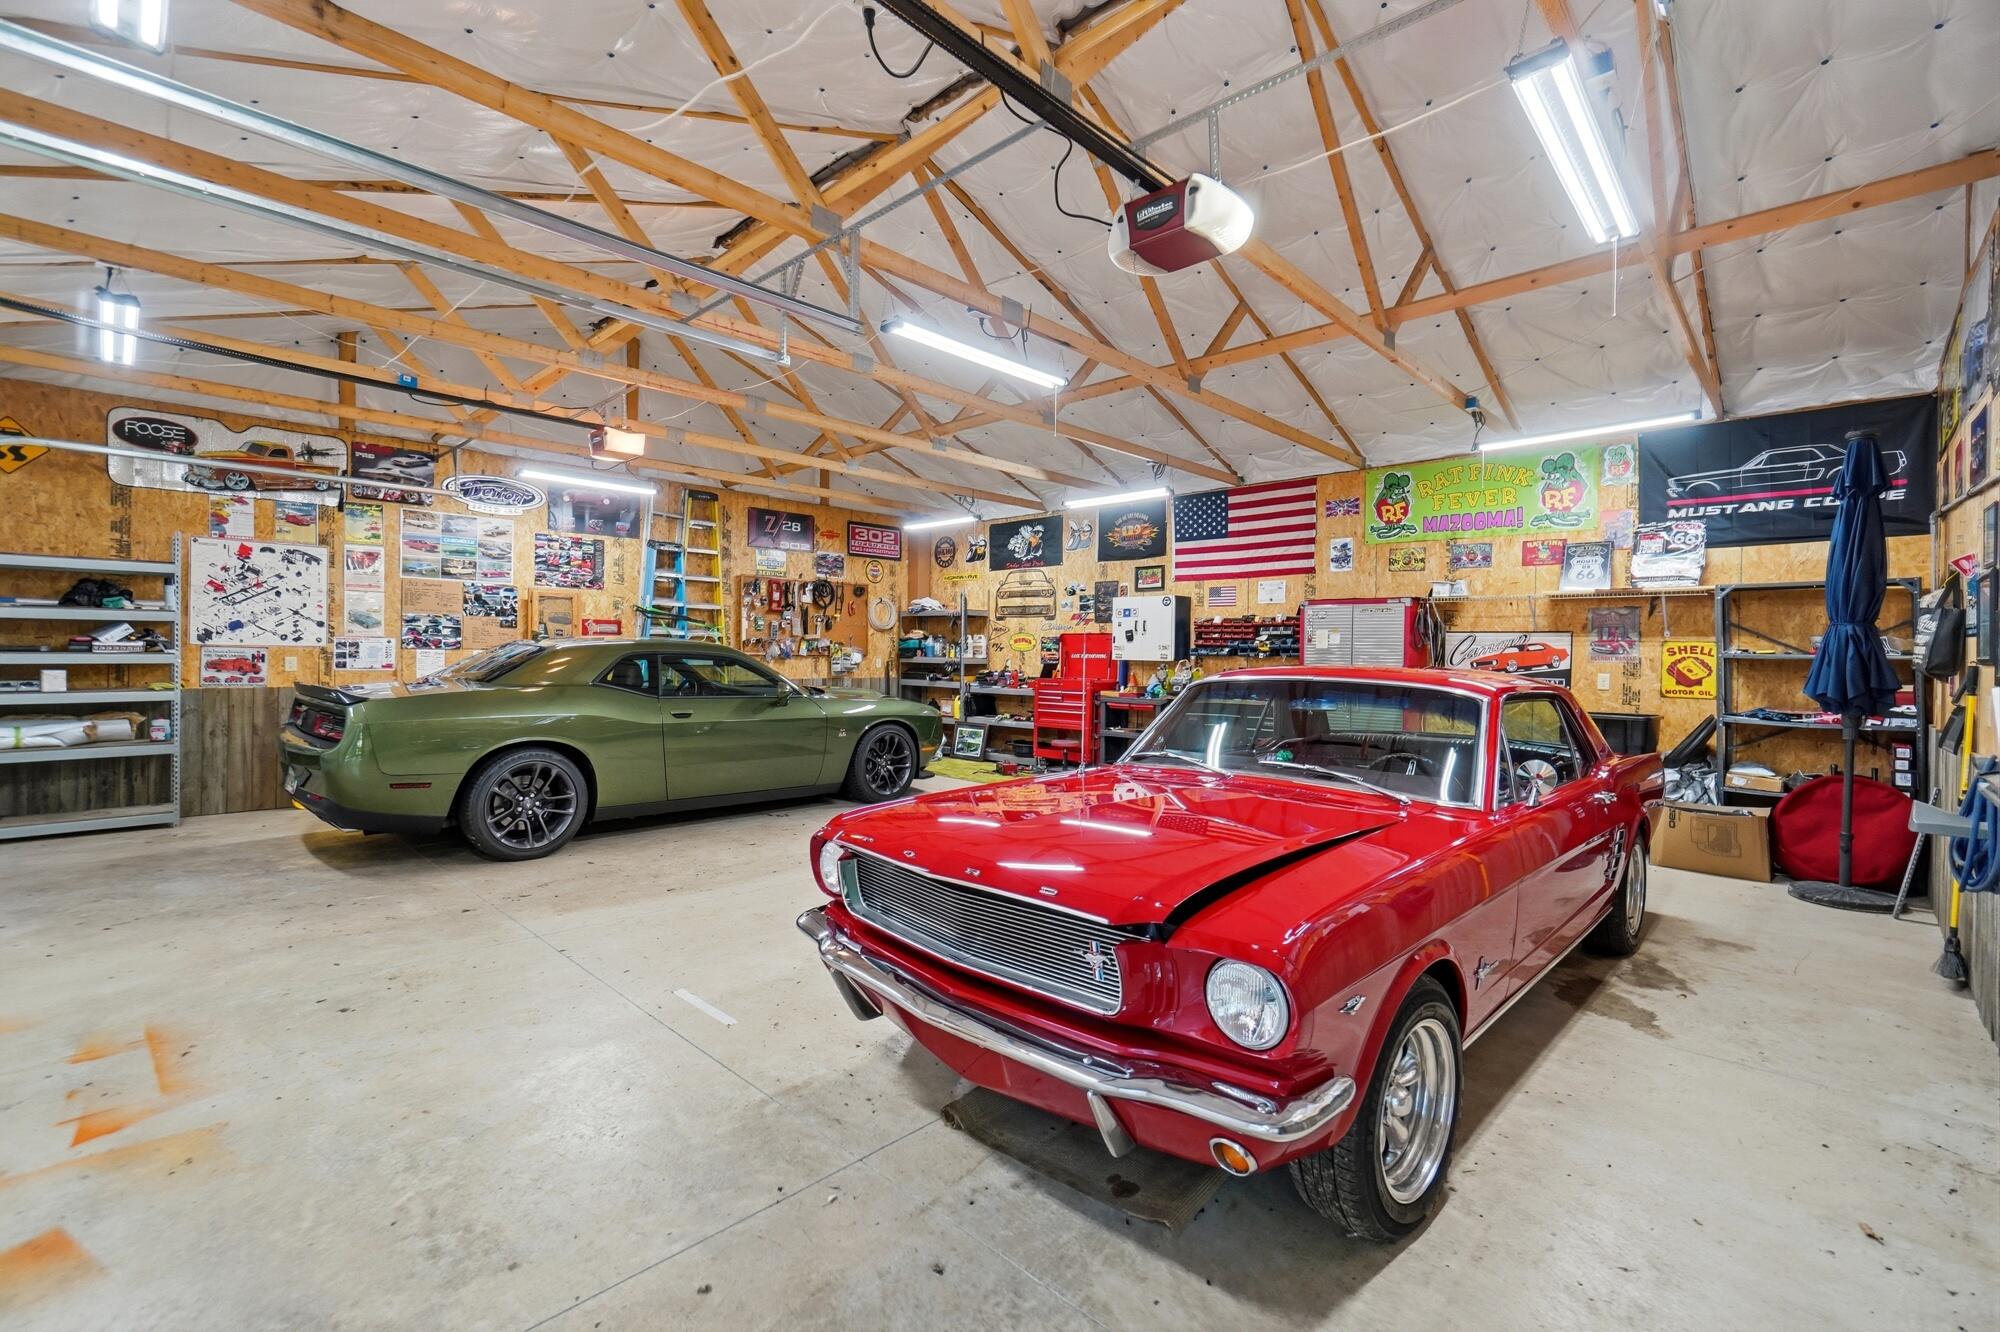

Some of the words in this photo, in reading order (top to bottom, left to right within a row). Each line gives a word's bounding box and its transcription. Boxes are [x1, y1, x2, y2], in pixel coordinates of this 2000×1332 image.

[1136, 201, 1174, 220] LiftMaster
[124, 419, 186, 440] FOOSE
[1415, 466, 1464, 498] RAT
[1469, 462, 1536, 487] FINK
[461, 480, 533, 505] Detroit
[1432, 487, 1518, 512] FEVER
[1667, 499, 1795, 519] MUSTANG
[1803, 489, 1907, 508] COE
[1422, 506, 1524, 533] MAZOOMA!
[855, 528, 895, 544] 302
[1673, 532, 1698, 545] 66
[1575, 569, 1596, 580] 66
[1446, 634, 1530, 667] Camaro
[1666, 645, 1715, 657] SHELL
